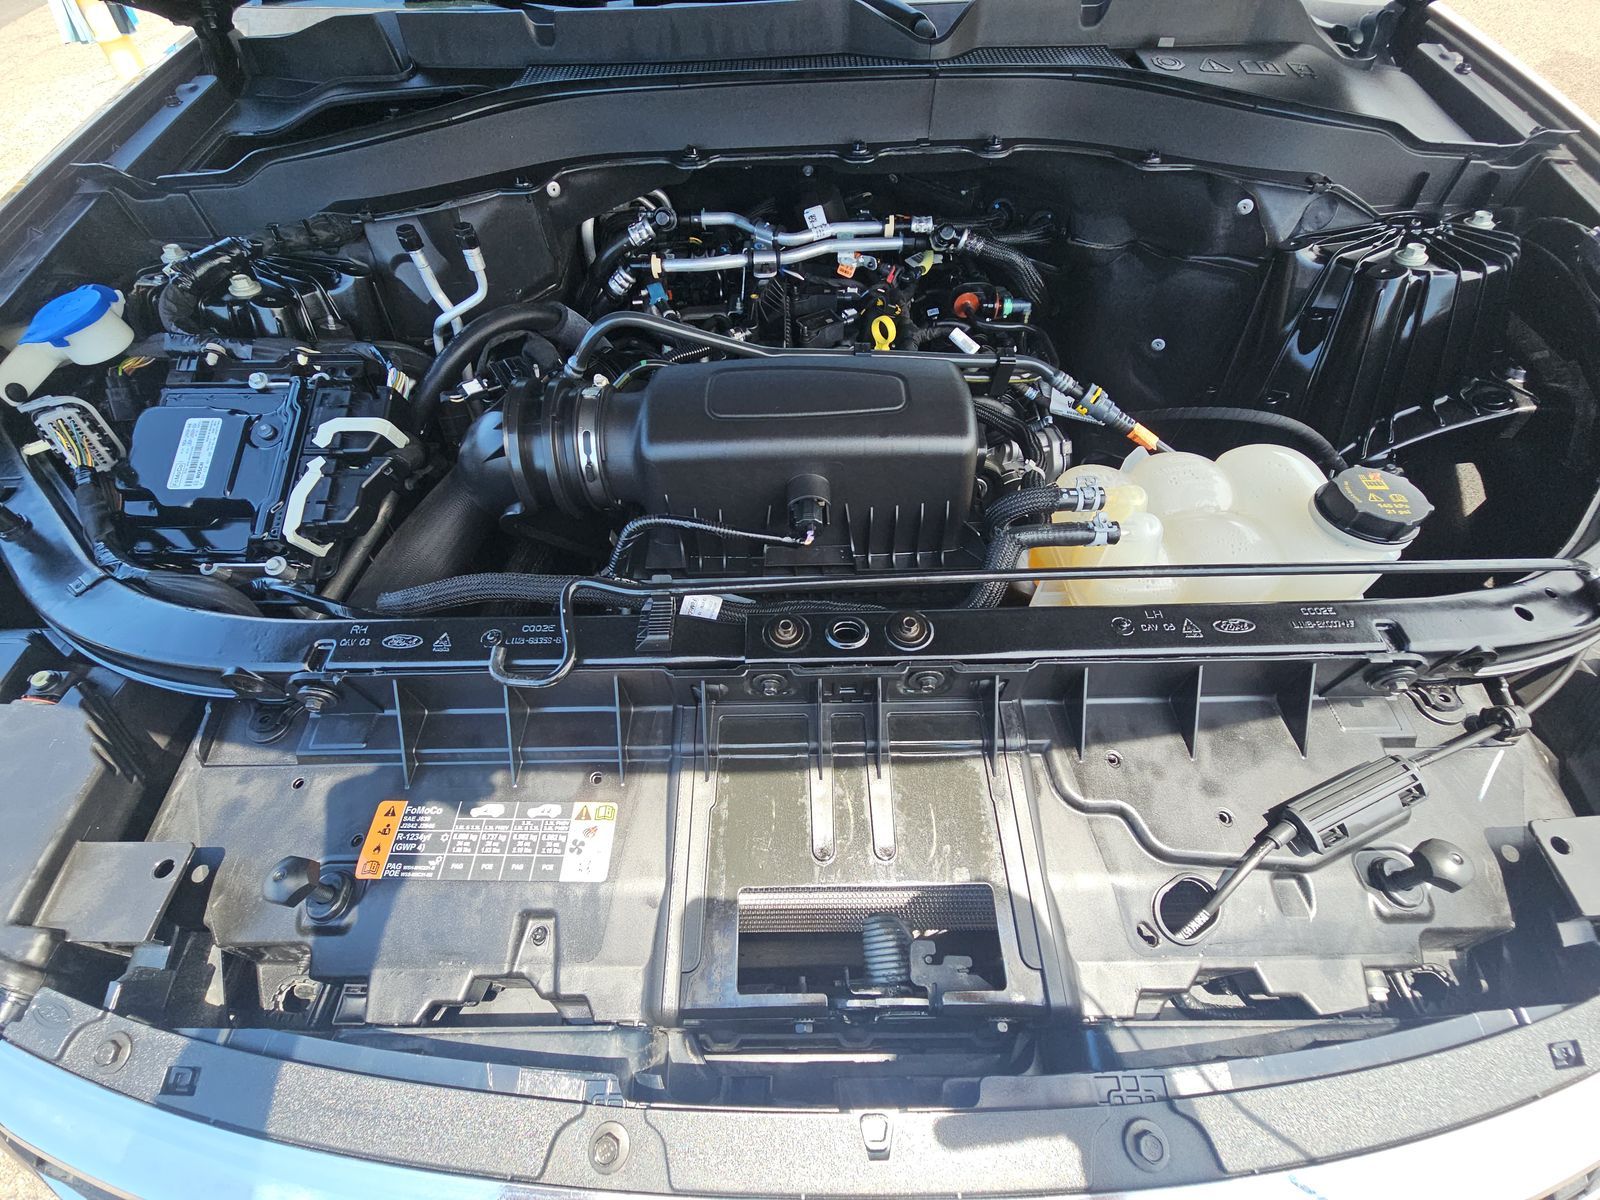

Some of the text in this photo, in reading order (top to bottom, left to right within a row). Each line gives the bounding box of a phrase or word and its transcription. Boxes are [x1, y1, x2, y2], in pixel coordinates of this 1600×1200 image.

[1144, 610, 1164, 619] LH
[350, 625, 368, 634] RH
[405, 806, 443, 814] FoMoCo
[396, 833, 432, 842] R-1234yf
[392, 843, 425, 852] (GWP 4)
